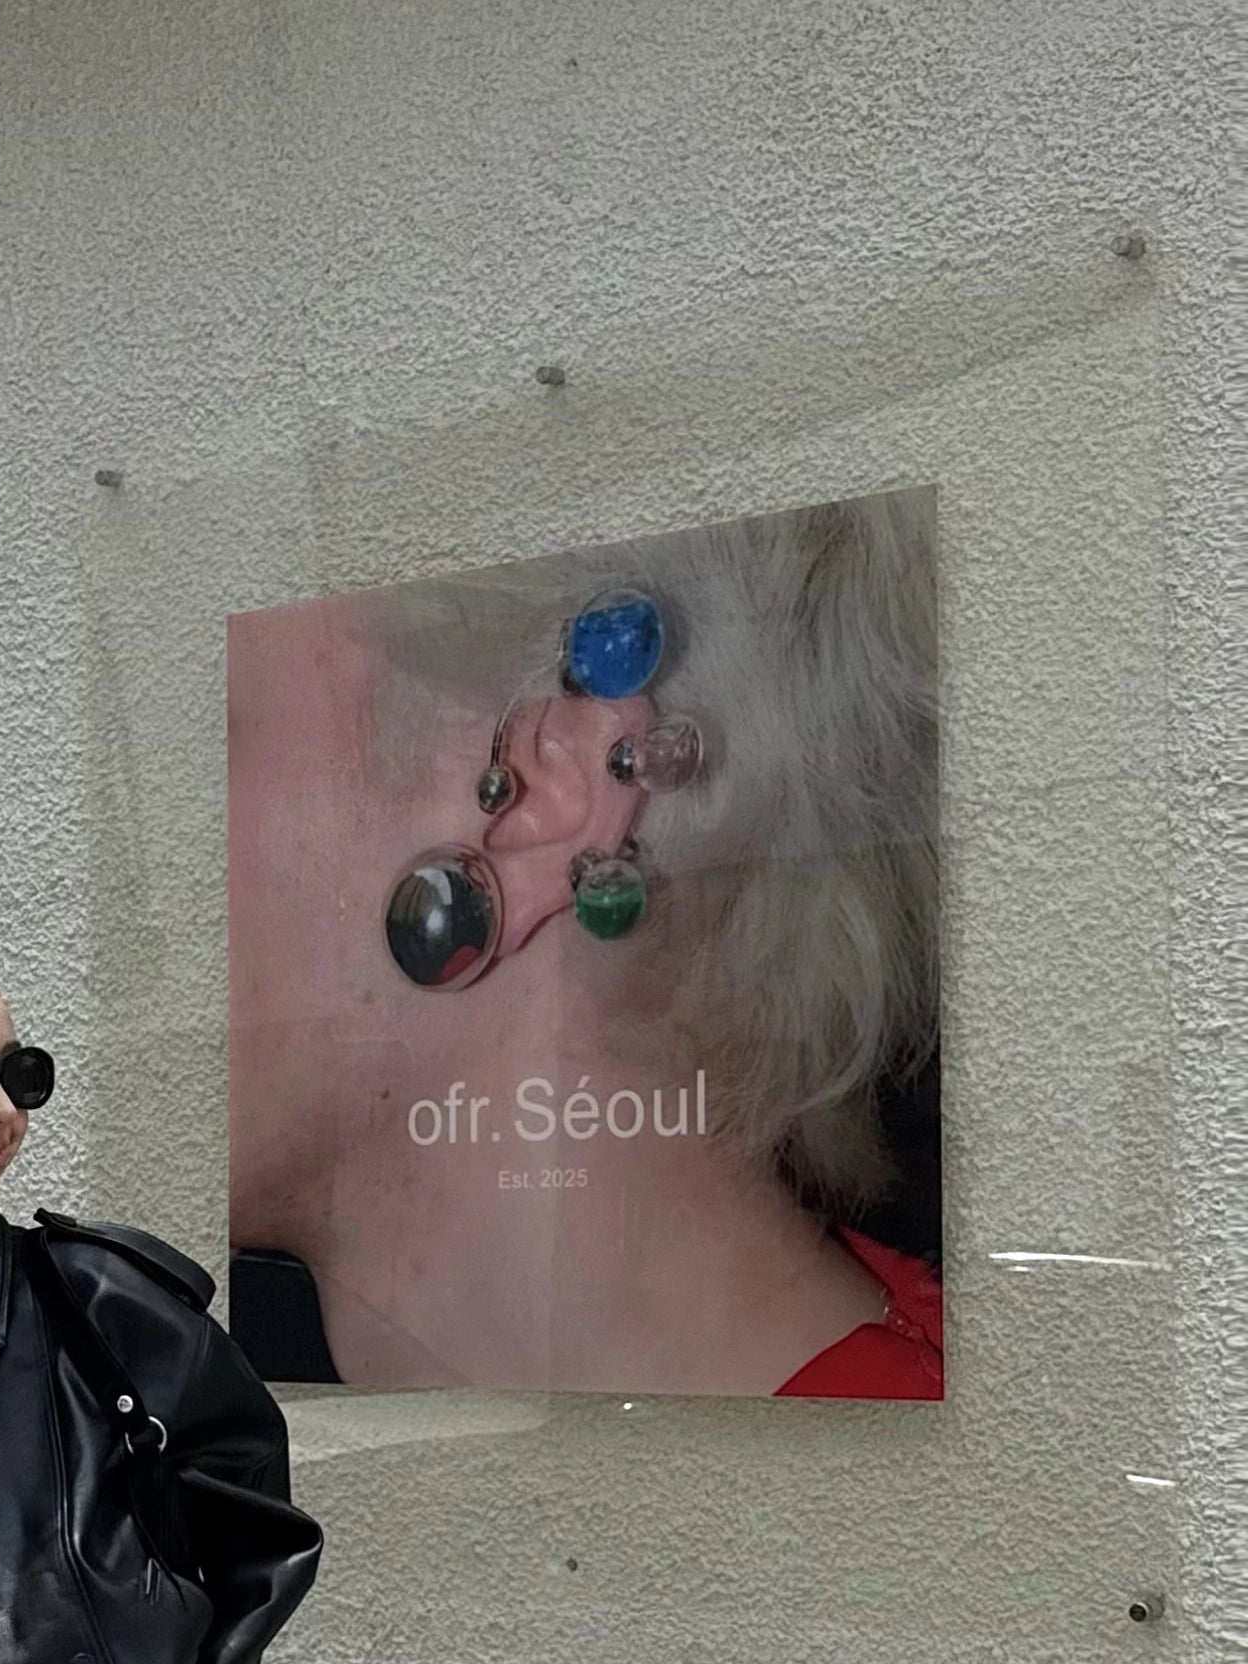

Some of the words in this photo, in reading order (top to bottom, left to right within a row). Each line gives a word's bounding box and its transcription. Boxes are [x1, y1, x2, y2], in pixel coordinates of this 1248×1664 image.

[408, 1082, 500, 1146] ofr.
[514, 1069, 706, 1141] Séoul
[498, 1170, 532, 1189] Est.
[540, 1168, 588, 1188] 2025
